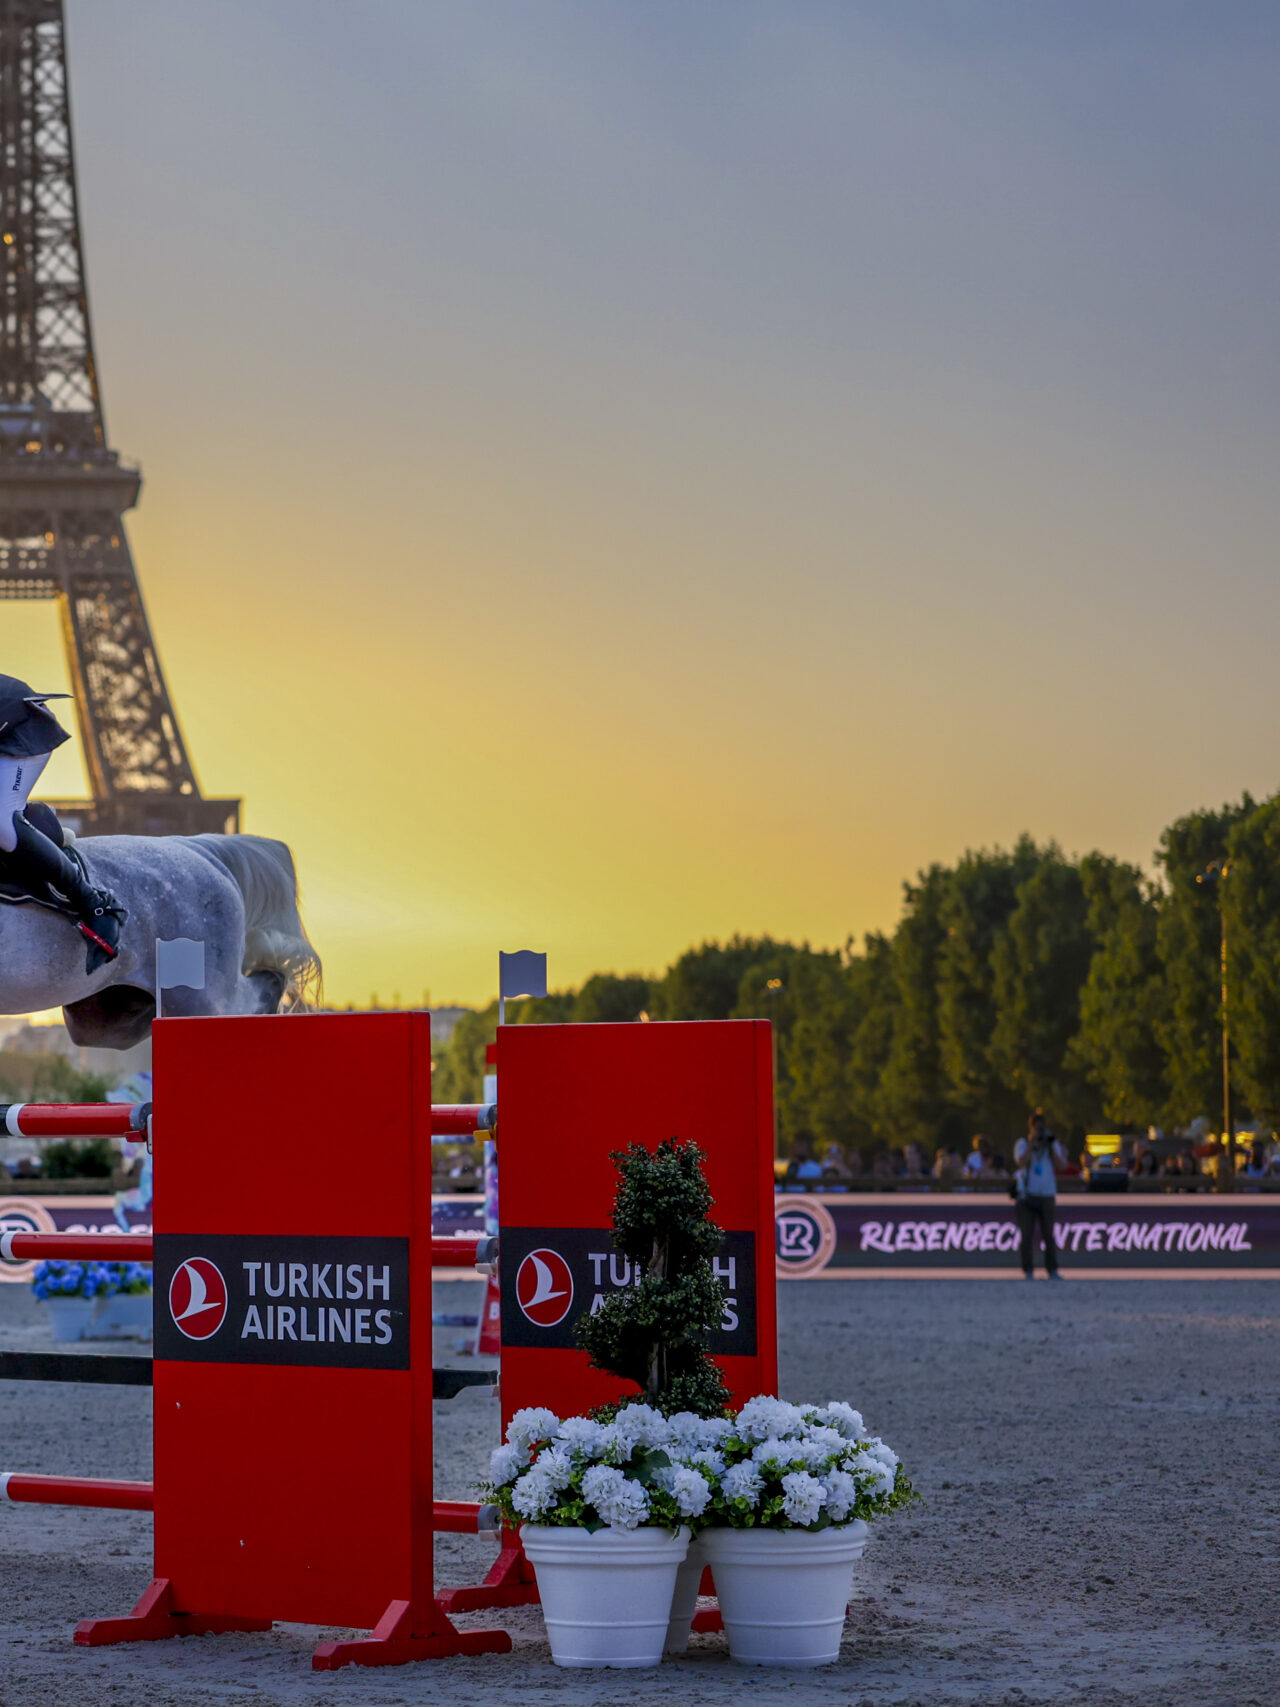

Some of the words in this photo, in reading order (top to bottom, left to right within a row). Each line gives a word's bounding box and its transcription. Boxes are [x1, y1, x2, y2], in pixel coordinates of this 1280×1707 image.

[1040, 1221, 1253, 1252] NTERNATIONAL
[242, 1261, 390, 1301] TURKISH
[240, 1304, 393, 1345] AIRLINES
